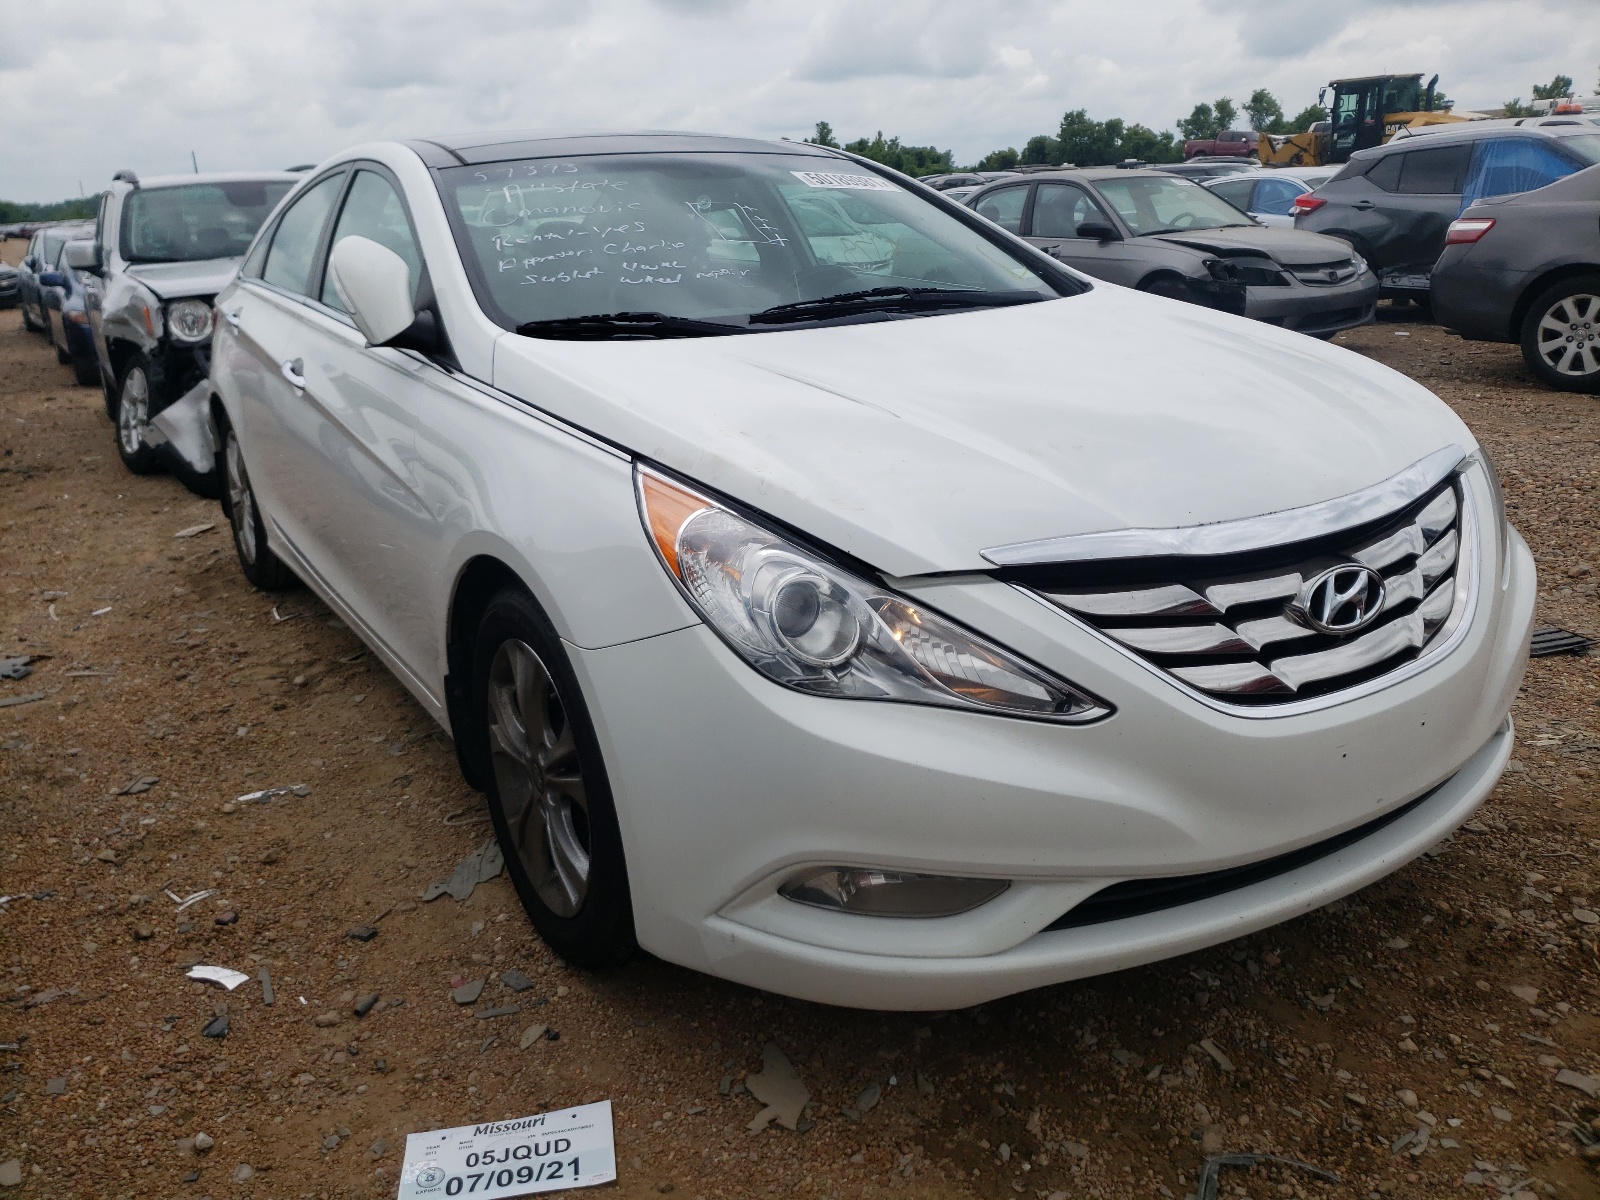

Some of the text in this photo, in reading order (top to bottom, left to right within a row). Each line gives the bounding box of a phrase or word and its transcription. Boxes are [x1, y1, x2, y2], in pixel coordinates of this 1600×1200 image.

[473, 1114, 546, 1137] Missouri
[1385, 1124, 1399, 1134] CAT
[465, 1138, 572, 1168] 05JQUD
[445, 1156, 580, 1196] 07/09/21
